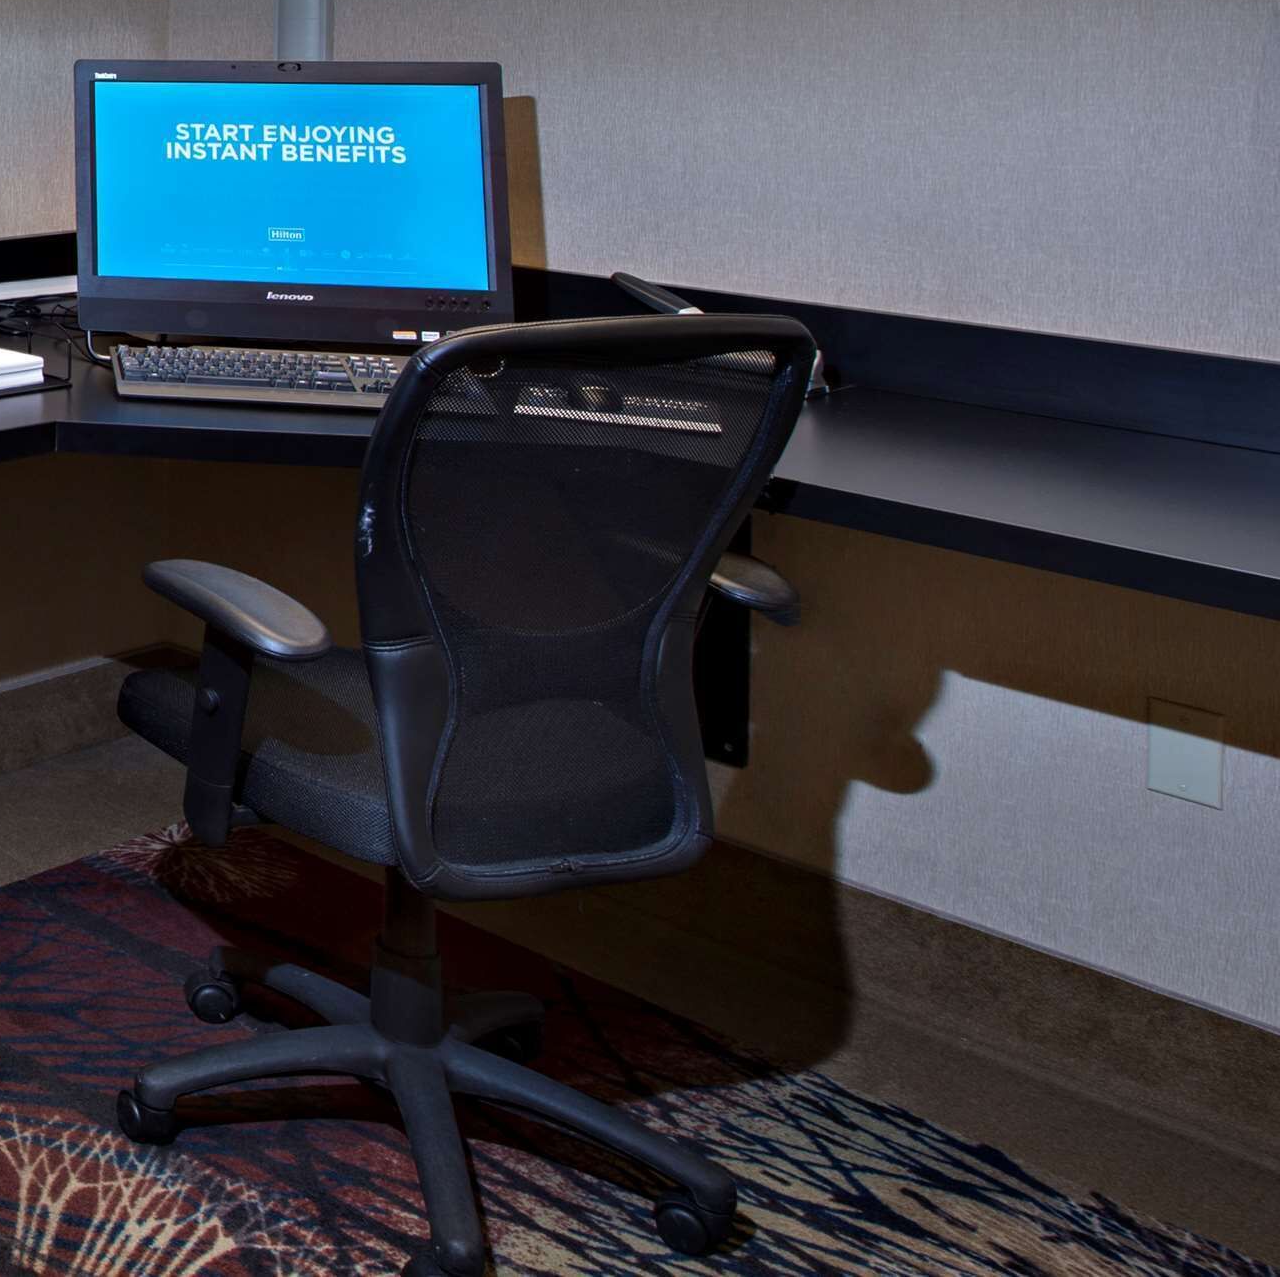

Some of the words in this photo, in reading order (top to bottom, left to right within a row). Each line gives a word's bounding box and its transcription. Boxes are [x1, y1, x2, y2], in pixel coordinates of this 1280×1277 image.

[176, 123, 255, 142] START
[262, 124, 396, 144] ENJOYING
[166, 142, 273, 161] INSTANT
[281, 144, 407, 164] BENEFITS
[271, 229, 302, 240] Hilton
[266, 291, 314, 302] lenovo
